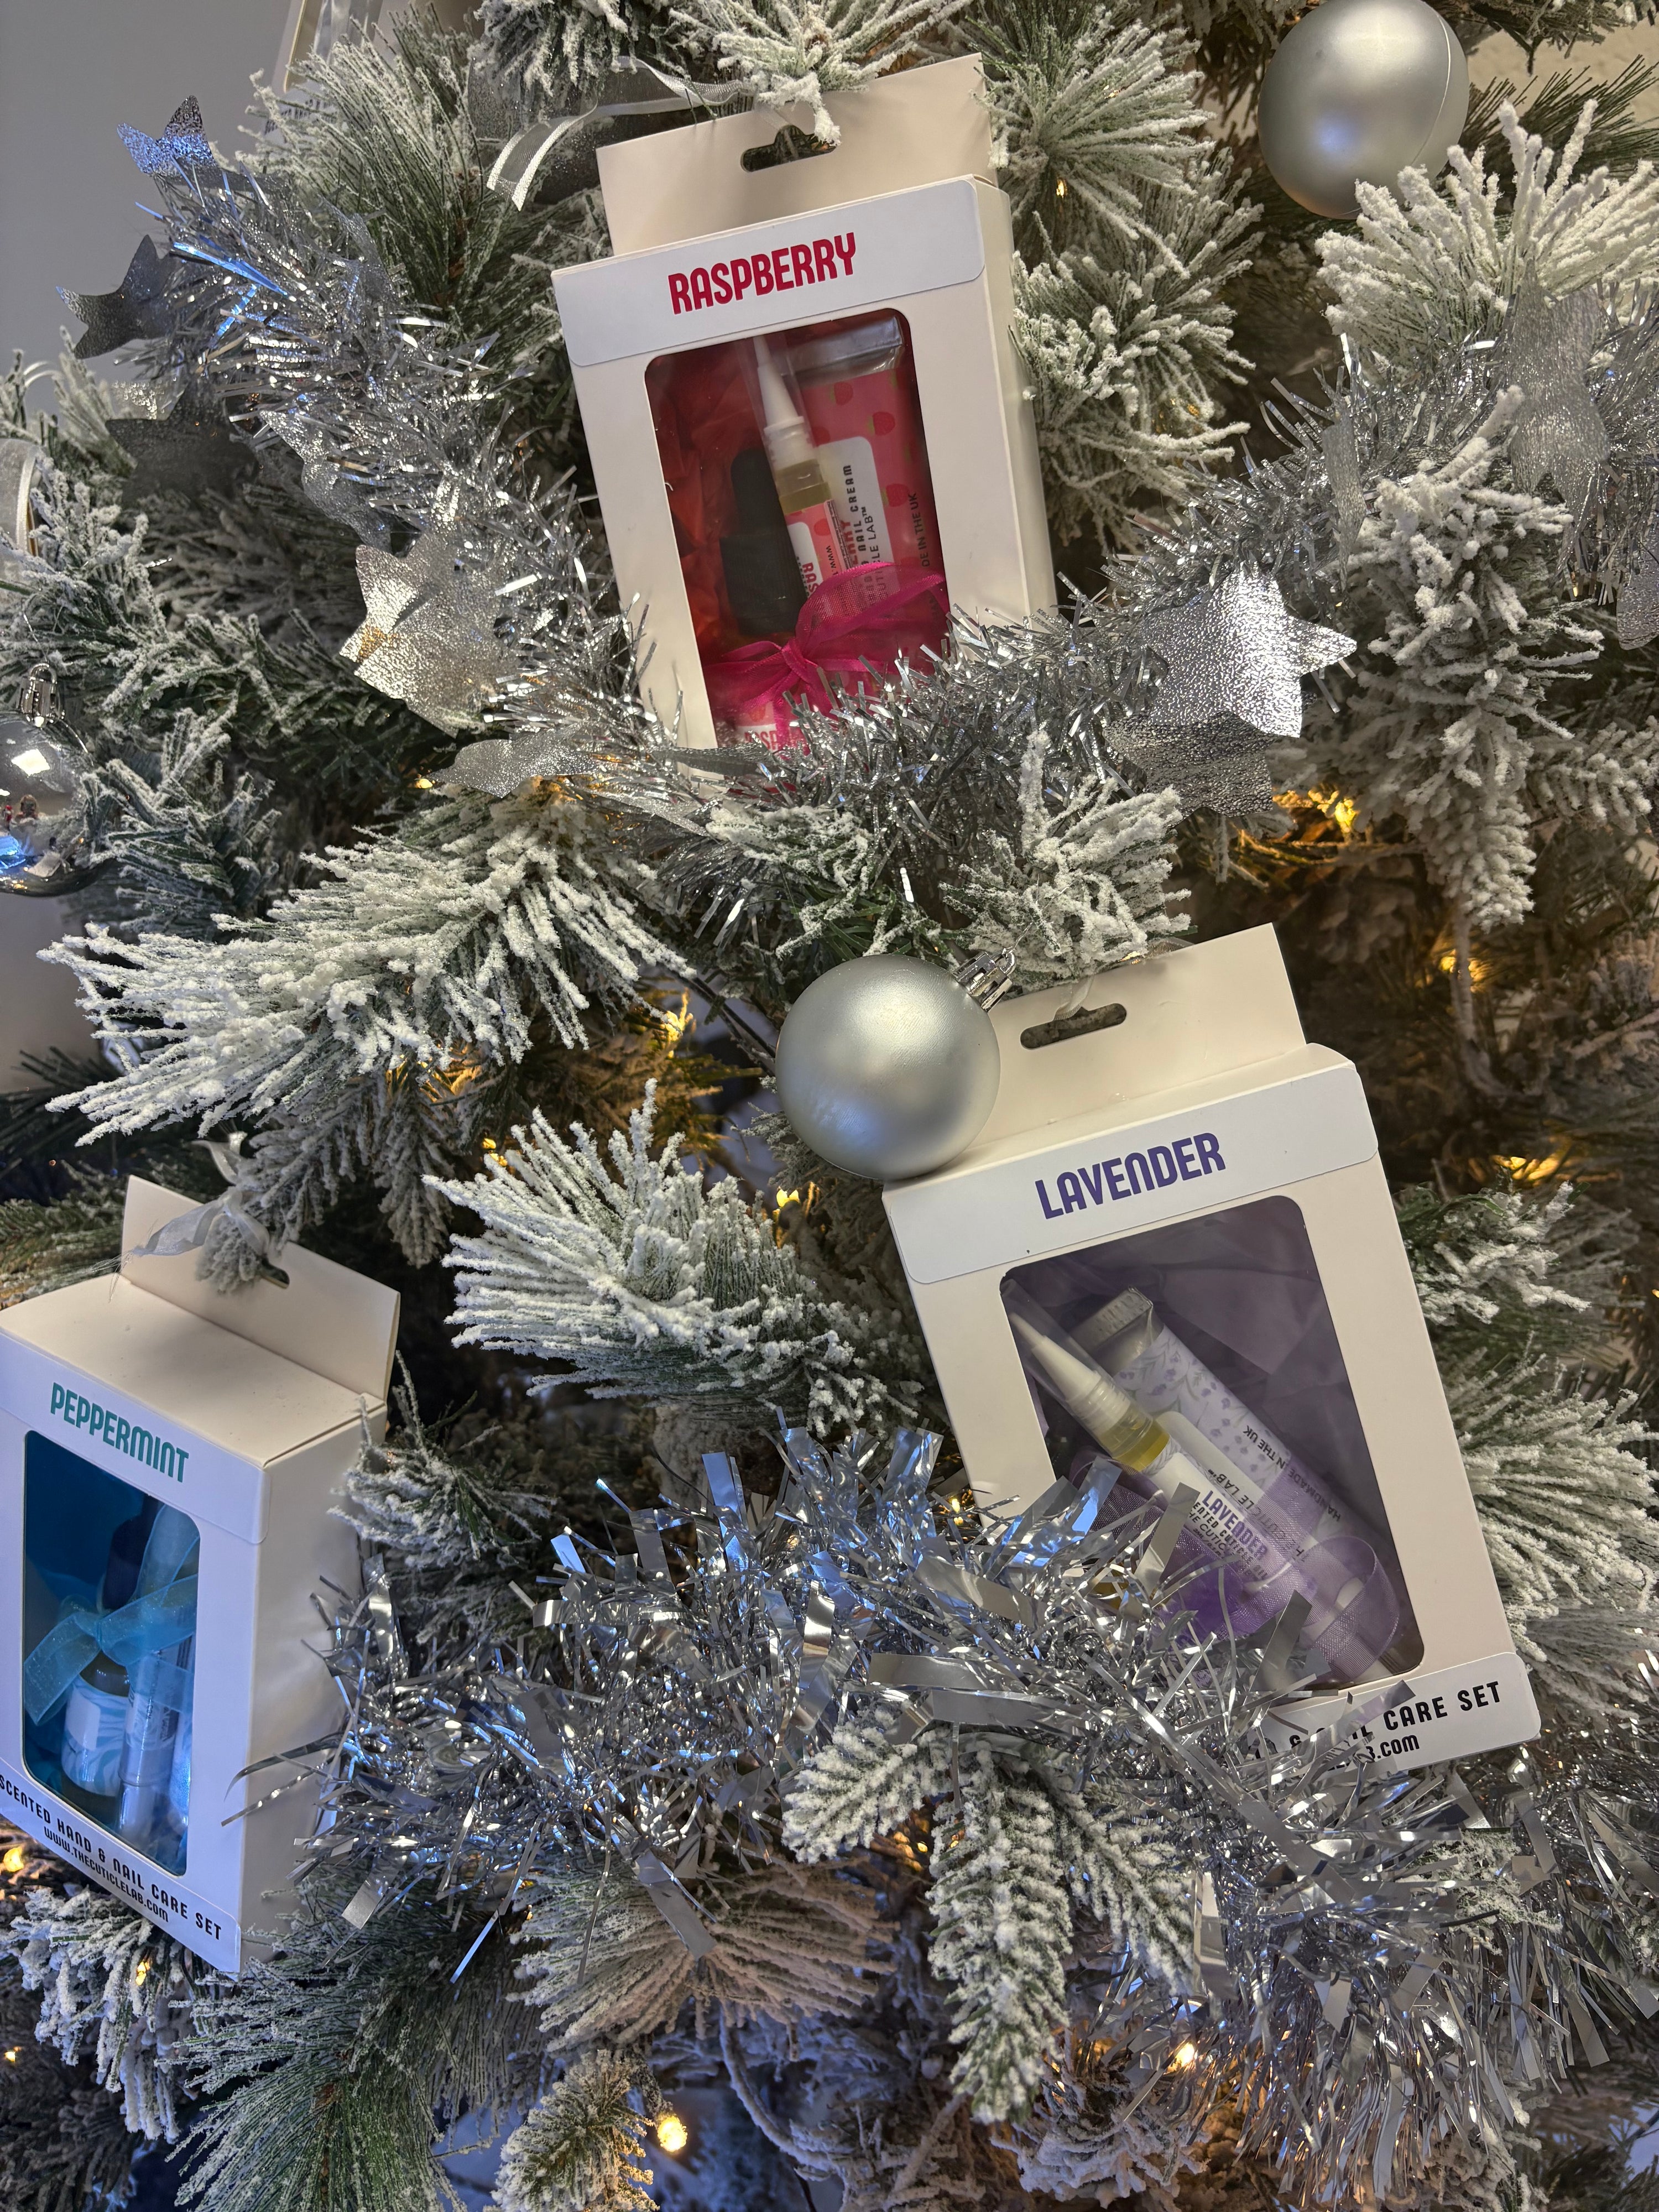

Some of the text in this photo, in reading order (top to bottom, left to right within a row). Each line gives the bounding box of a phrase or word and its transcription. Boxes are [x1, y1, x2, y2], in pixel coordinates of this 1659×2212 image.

[668, 232, 856, 315] RASPBERRY
[843, 465, 859, 512] CREAM
[908, 493, 920, 510] UK
[854, 520, 867, 551] NAIL
[912, 512, 924, 535] THE
[916, 537, 927, 551] IN
[1035, 1133, 1226, 1219] LAVENDER
[50, 1382, 189, 1483] PEPPERMINT
[1243, 1425, 1258, 1443] UK
[1258, 1439, 1276, 1461] THE
[1193, 1501, 1219, 1528] ENTED
[1288, 1468, 1341, 1521] HANDMADE
[1202, 1490, 1268, 1561] LAVENDER
[1383, 1697, 1448, 1731] CARE
[1457, 1681, 1501, 1712] SET
[0, 1775, 222, 1940] SCENTED HAND & NAIL CARE SET
[44, 1826, 169, 1923] WWW.THECUTICLELAB.COM
